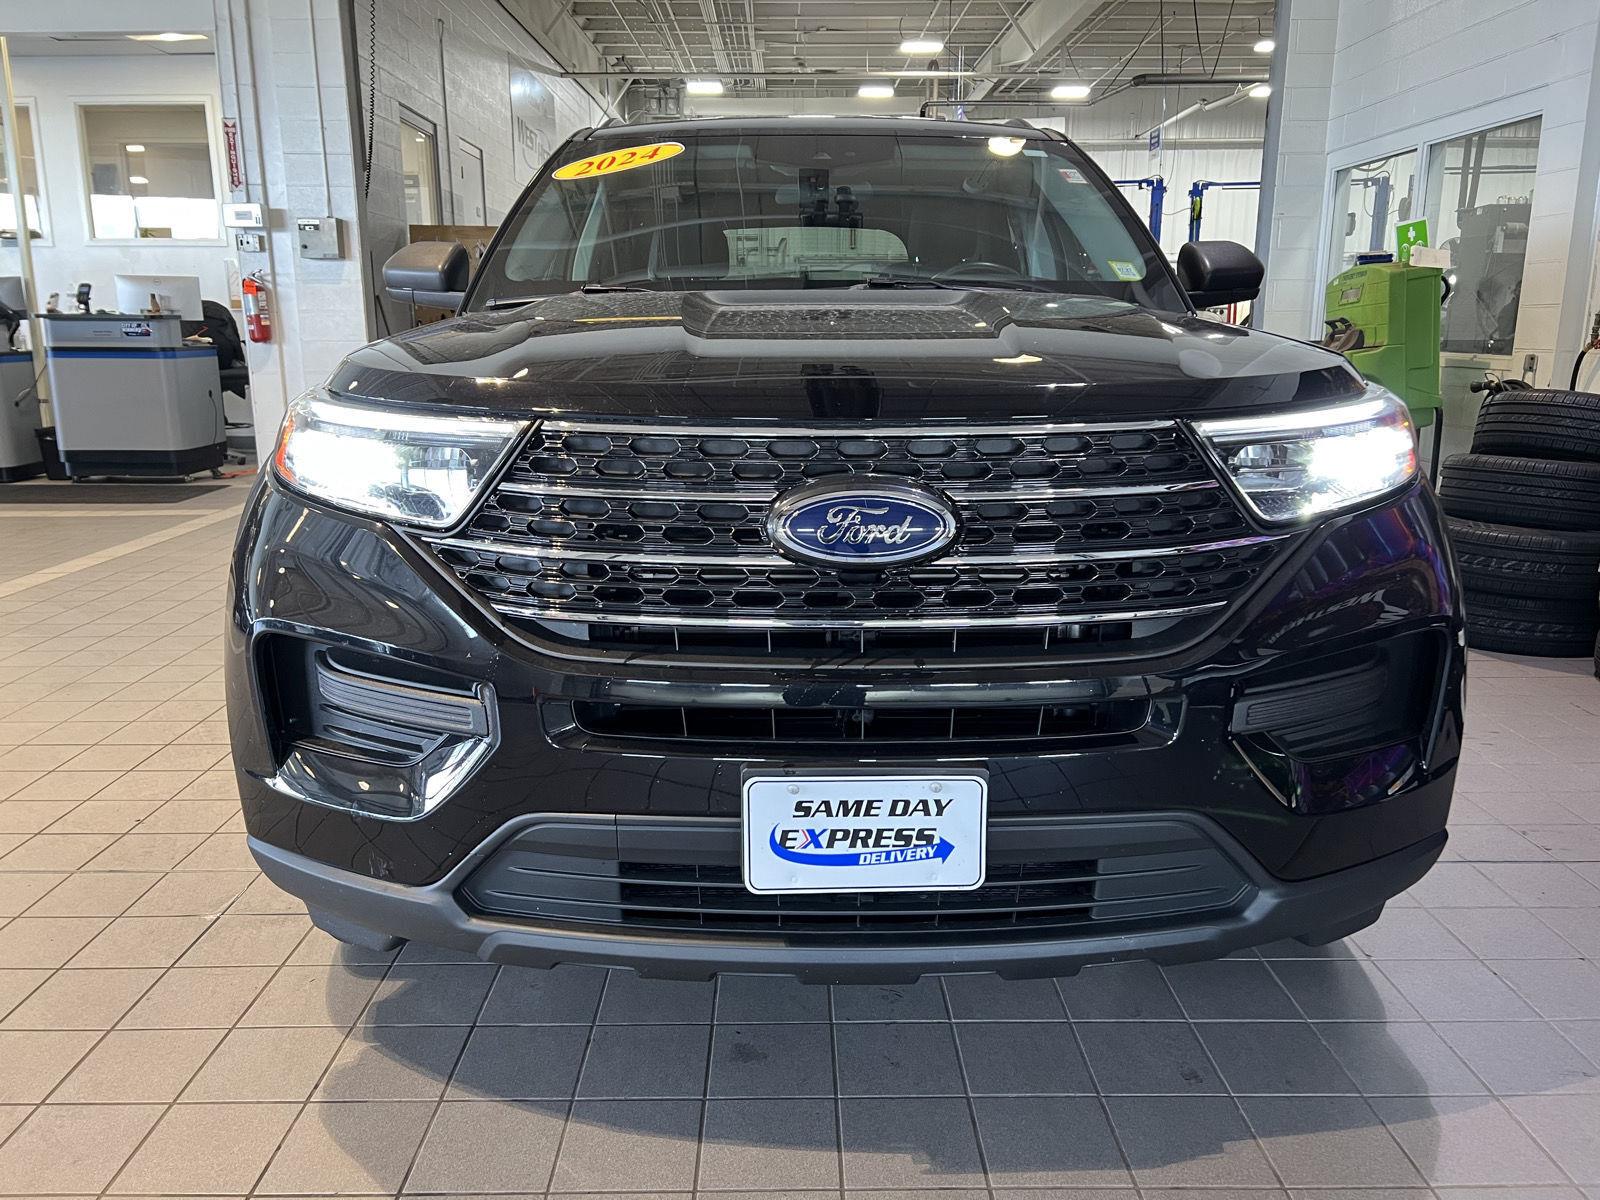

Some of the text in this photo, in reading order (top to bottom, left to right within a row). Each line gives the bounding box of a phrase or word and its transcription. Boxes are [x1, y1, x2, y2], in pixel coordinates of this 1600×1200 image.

[517, 116, 538, 153] WEST
[574, 146, 662, 176] 2024
[816, 505, 913, 545] Ford
[792, 798, 954, 818] SAME DAY
[778, 827, 938, 850] EXPRESS
[858, 845, 938, 866] DELIVERY
